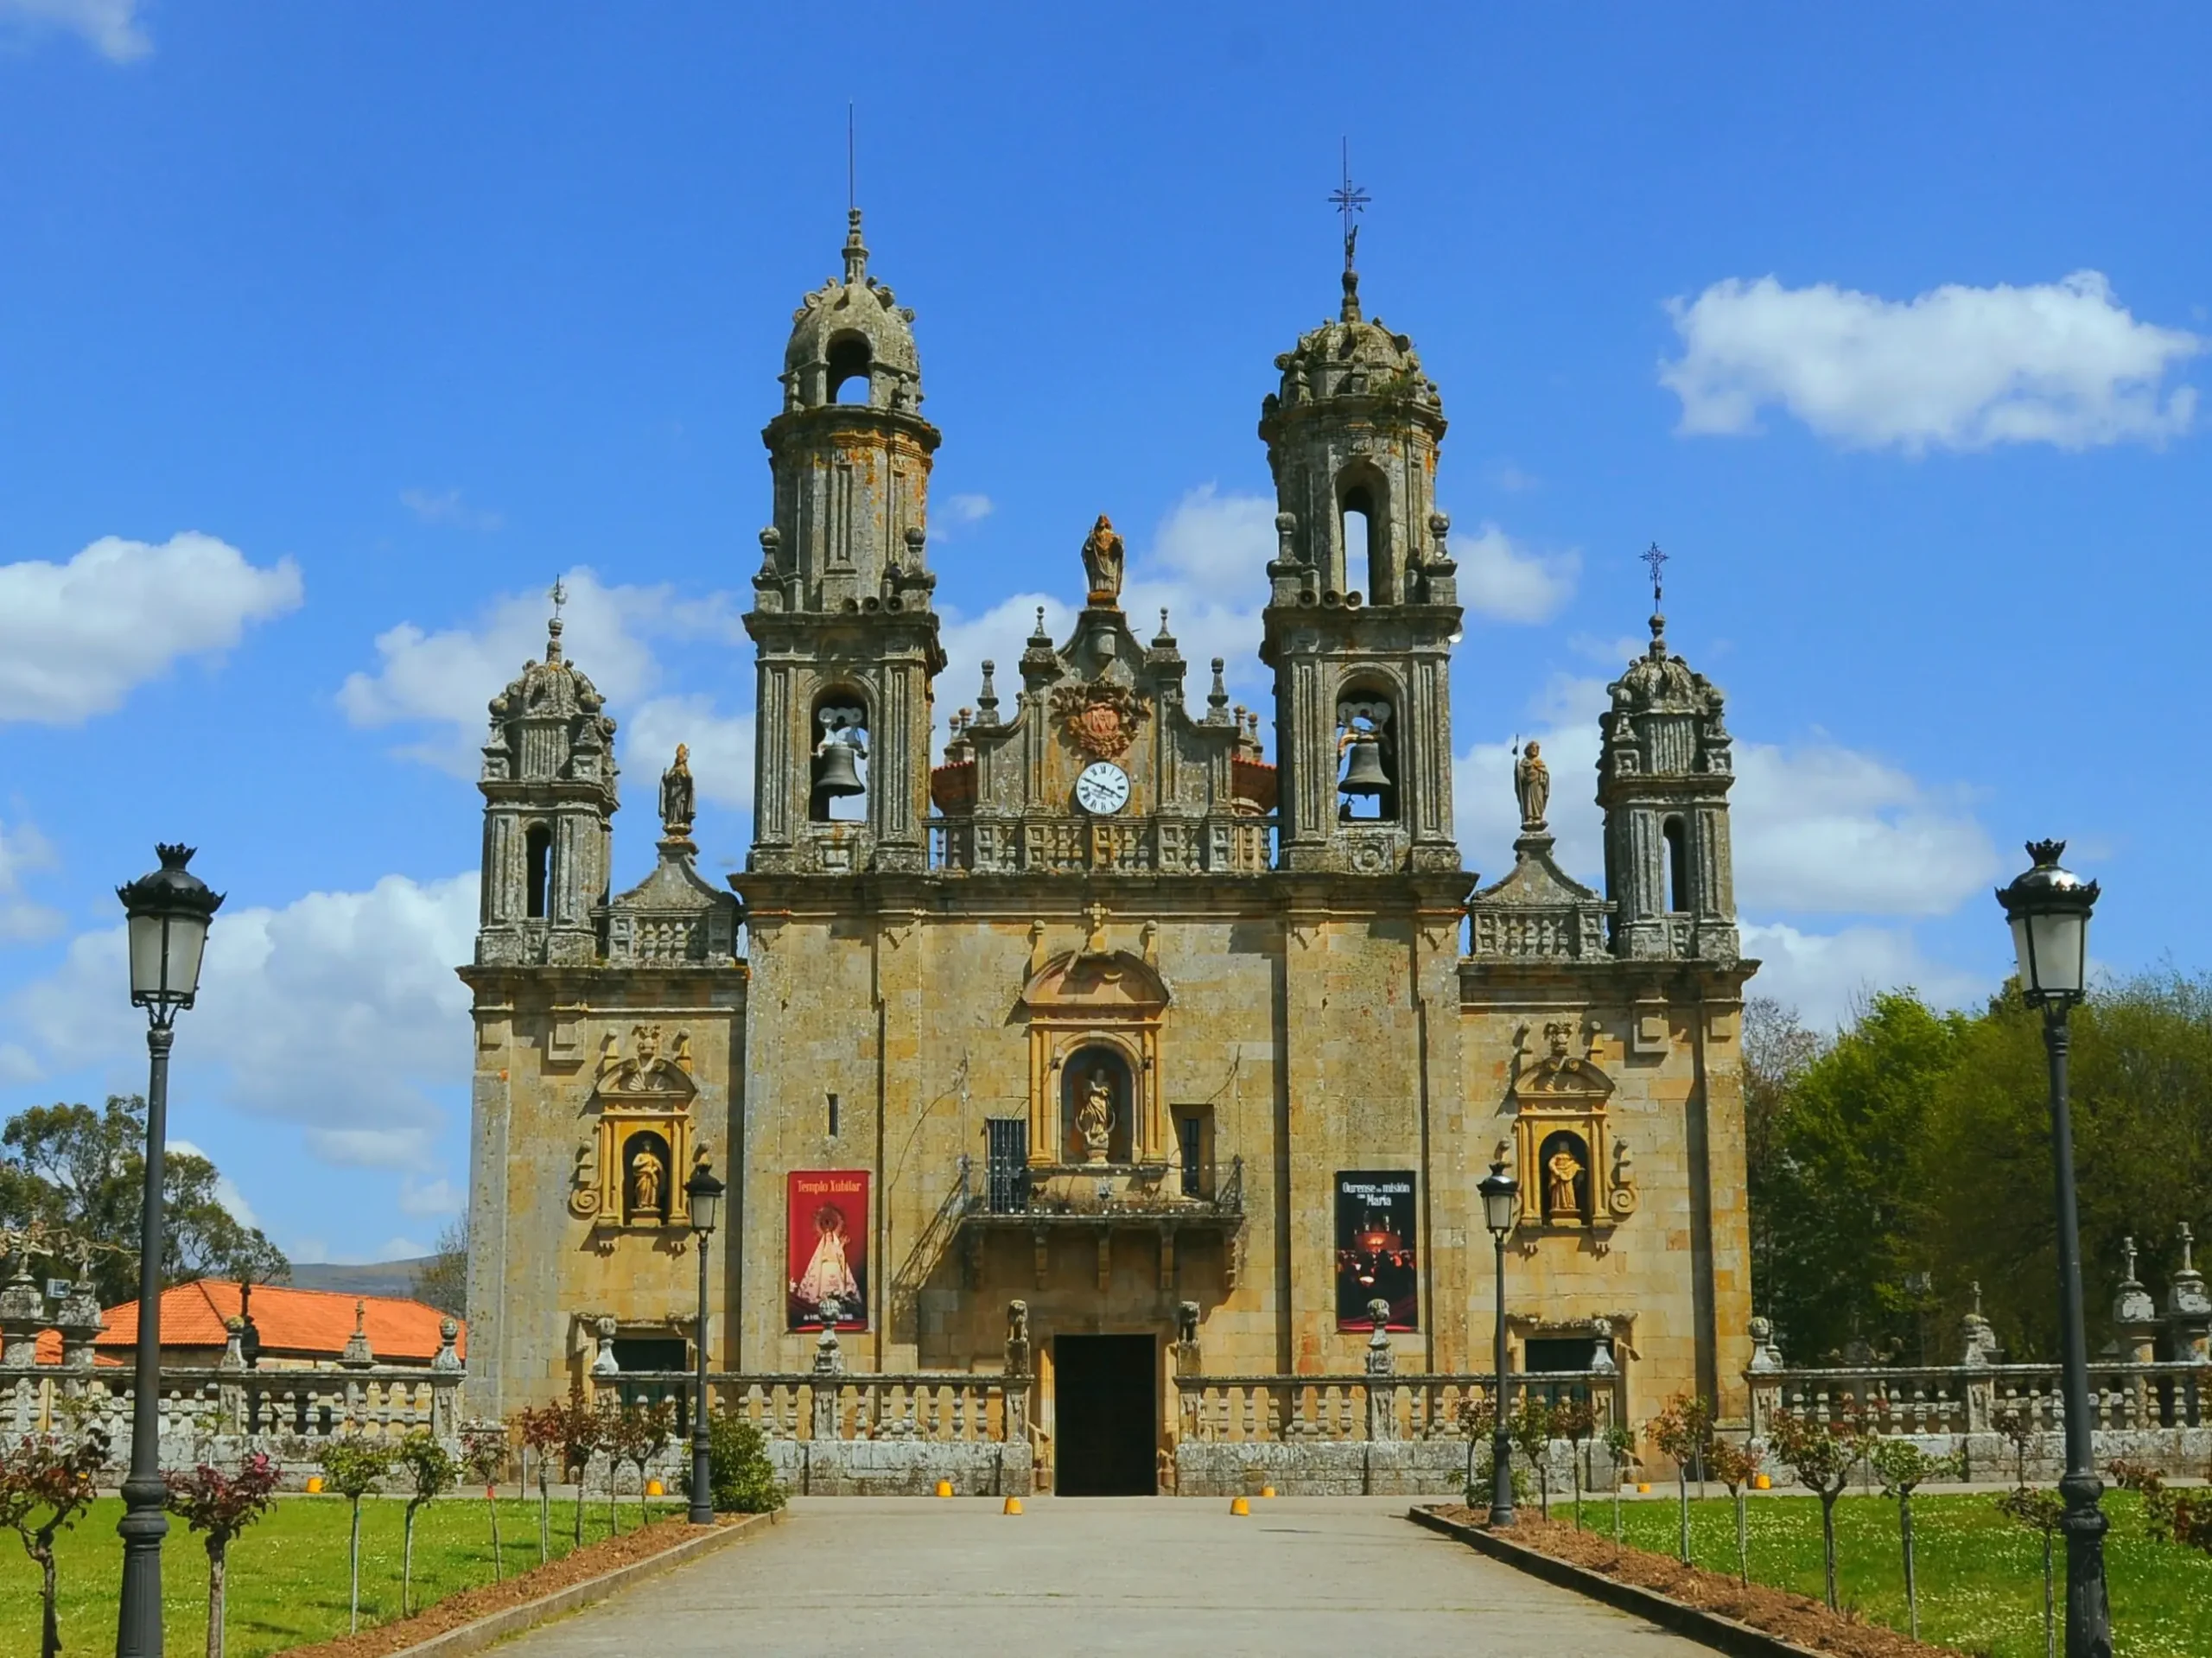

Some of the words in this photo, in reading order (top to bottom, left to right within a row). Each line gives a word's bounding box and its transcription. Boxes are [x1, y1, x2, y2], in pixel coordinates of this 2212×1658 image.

[798, 1180, 828, 1196] Templo
[830, 1179, 861, 1192] Xubilar
[1342, 1182, 1376, 1193] Ourense
[1366, 1194, 1392, 1206] María
